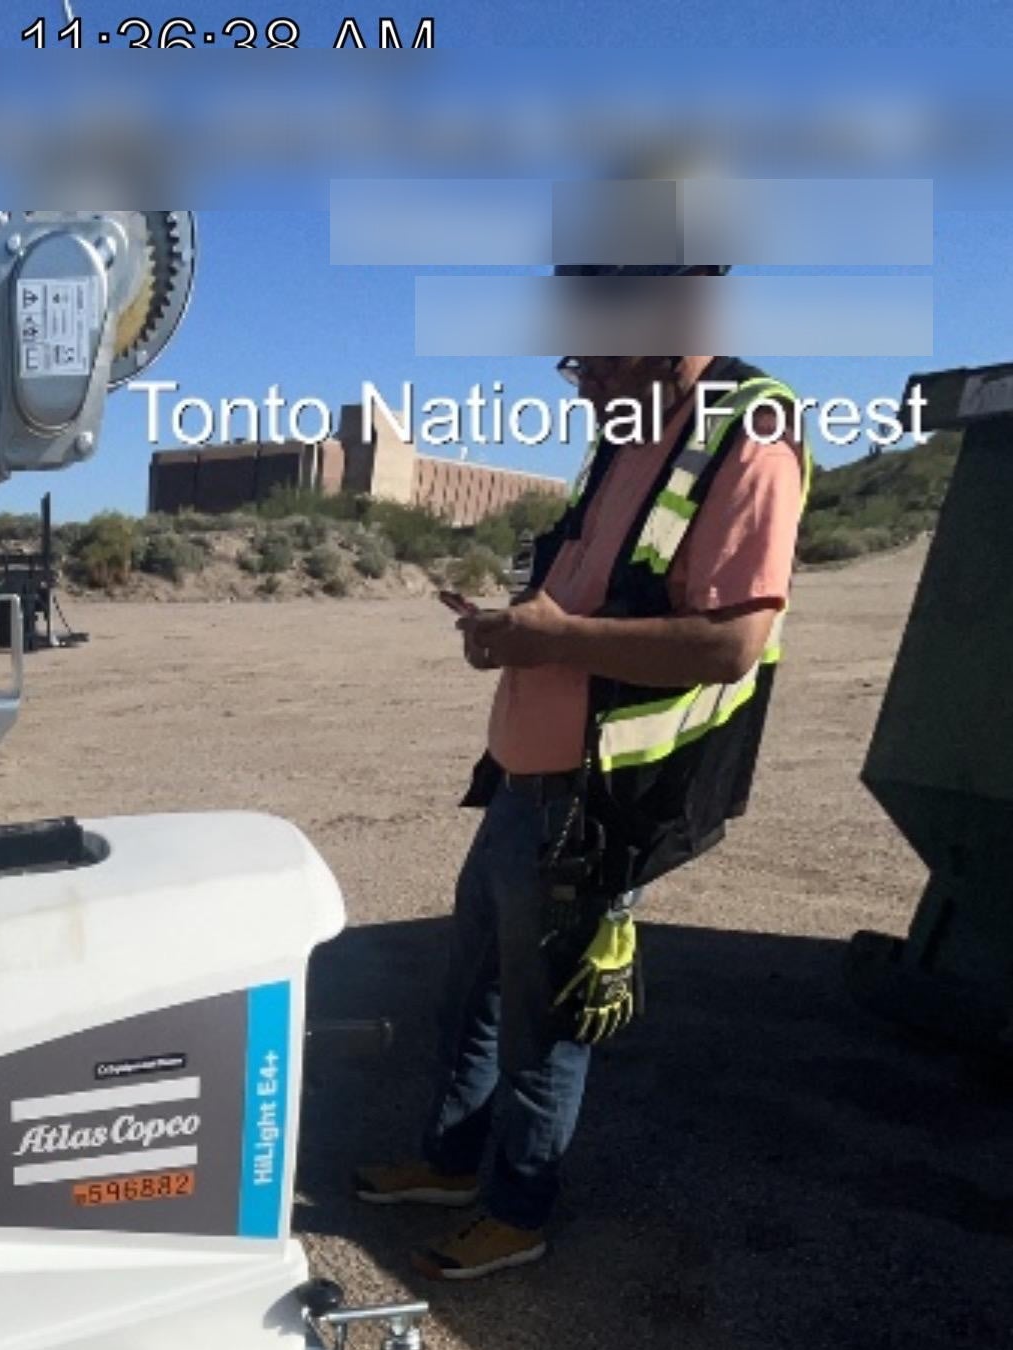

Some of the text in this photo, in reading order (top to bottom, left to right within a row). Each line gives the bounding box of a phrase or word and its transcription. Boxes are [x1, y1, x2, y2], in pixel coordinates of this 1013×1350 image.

[13, 1114, 200, 1156] Atlas Copco
[252, 1049, 279, 1186] HiLight E4+
